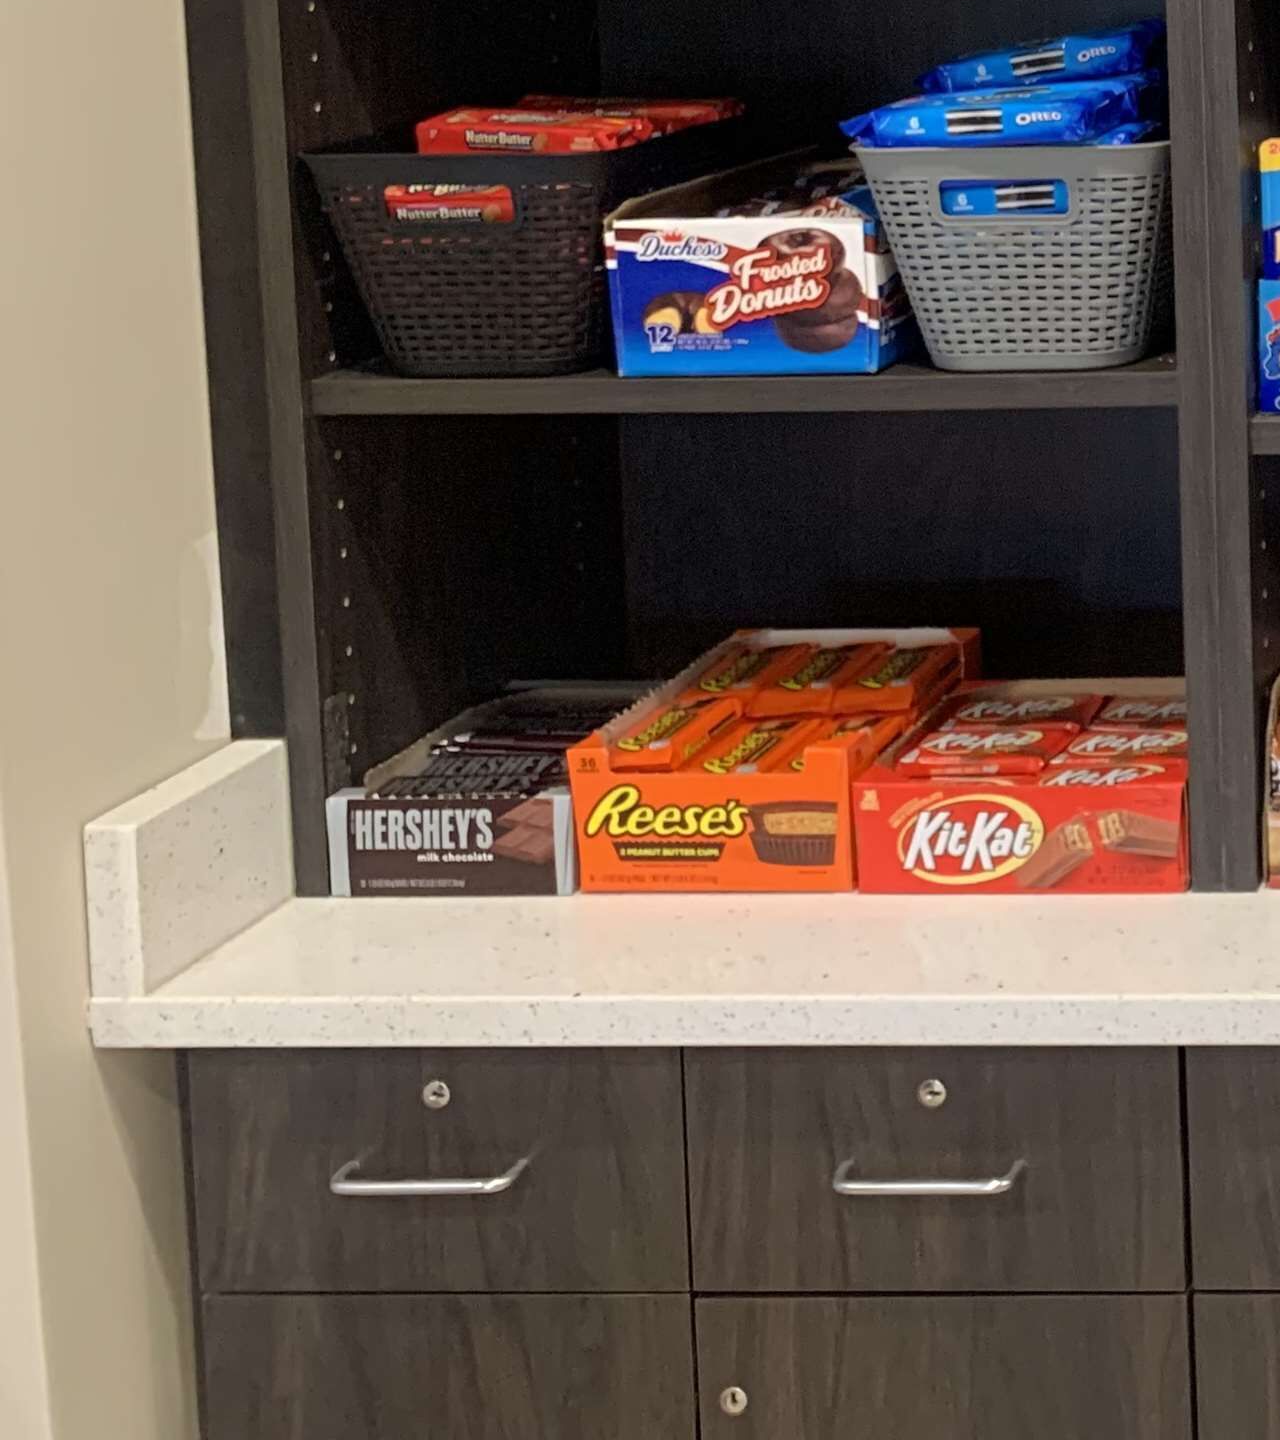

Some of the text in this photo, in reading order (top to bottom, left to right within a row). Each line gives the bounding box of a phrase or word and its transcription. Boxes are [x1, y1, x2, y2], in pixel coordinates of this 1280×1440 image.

[1077, 45, 1116, 63] OREO
[1015, 110, 1062, 126] OREO
[638, 233, 728, 260] Duchess
[733, 248, 827, 289] Frosted
[710, 278, 823, 323] Donuts
[648, 325, 675, 344] 12
[585, 784, 749, 838] Reese's
[355, 808, 493, 851] HERSHEY'S
[417, 851, 494, 862] milk chocolate
[627, 848, 720, 857] PEANUT BUTTER CUPS
